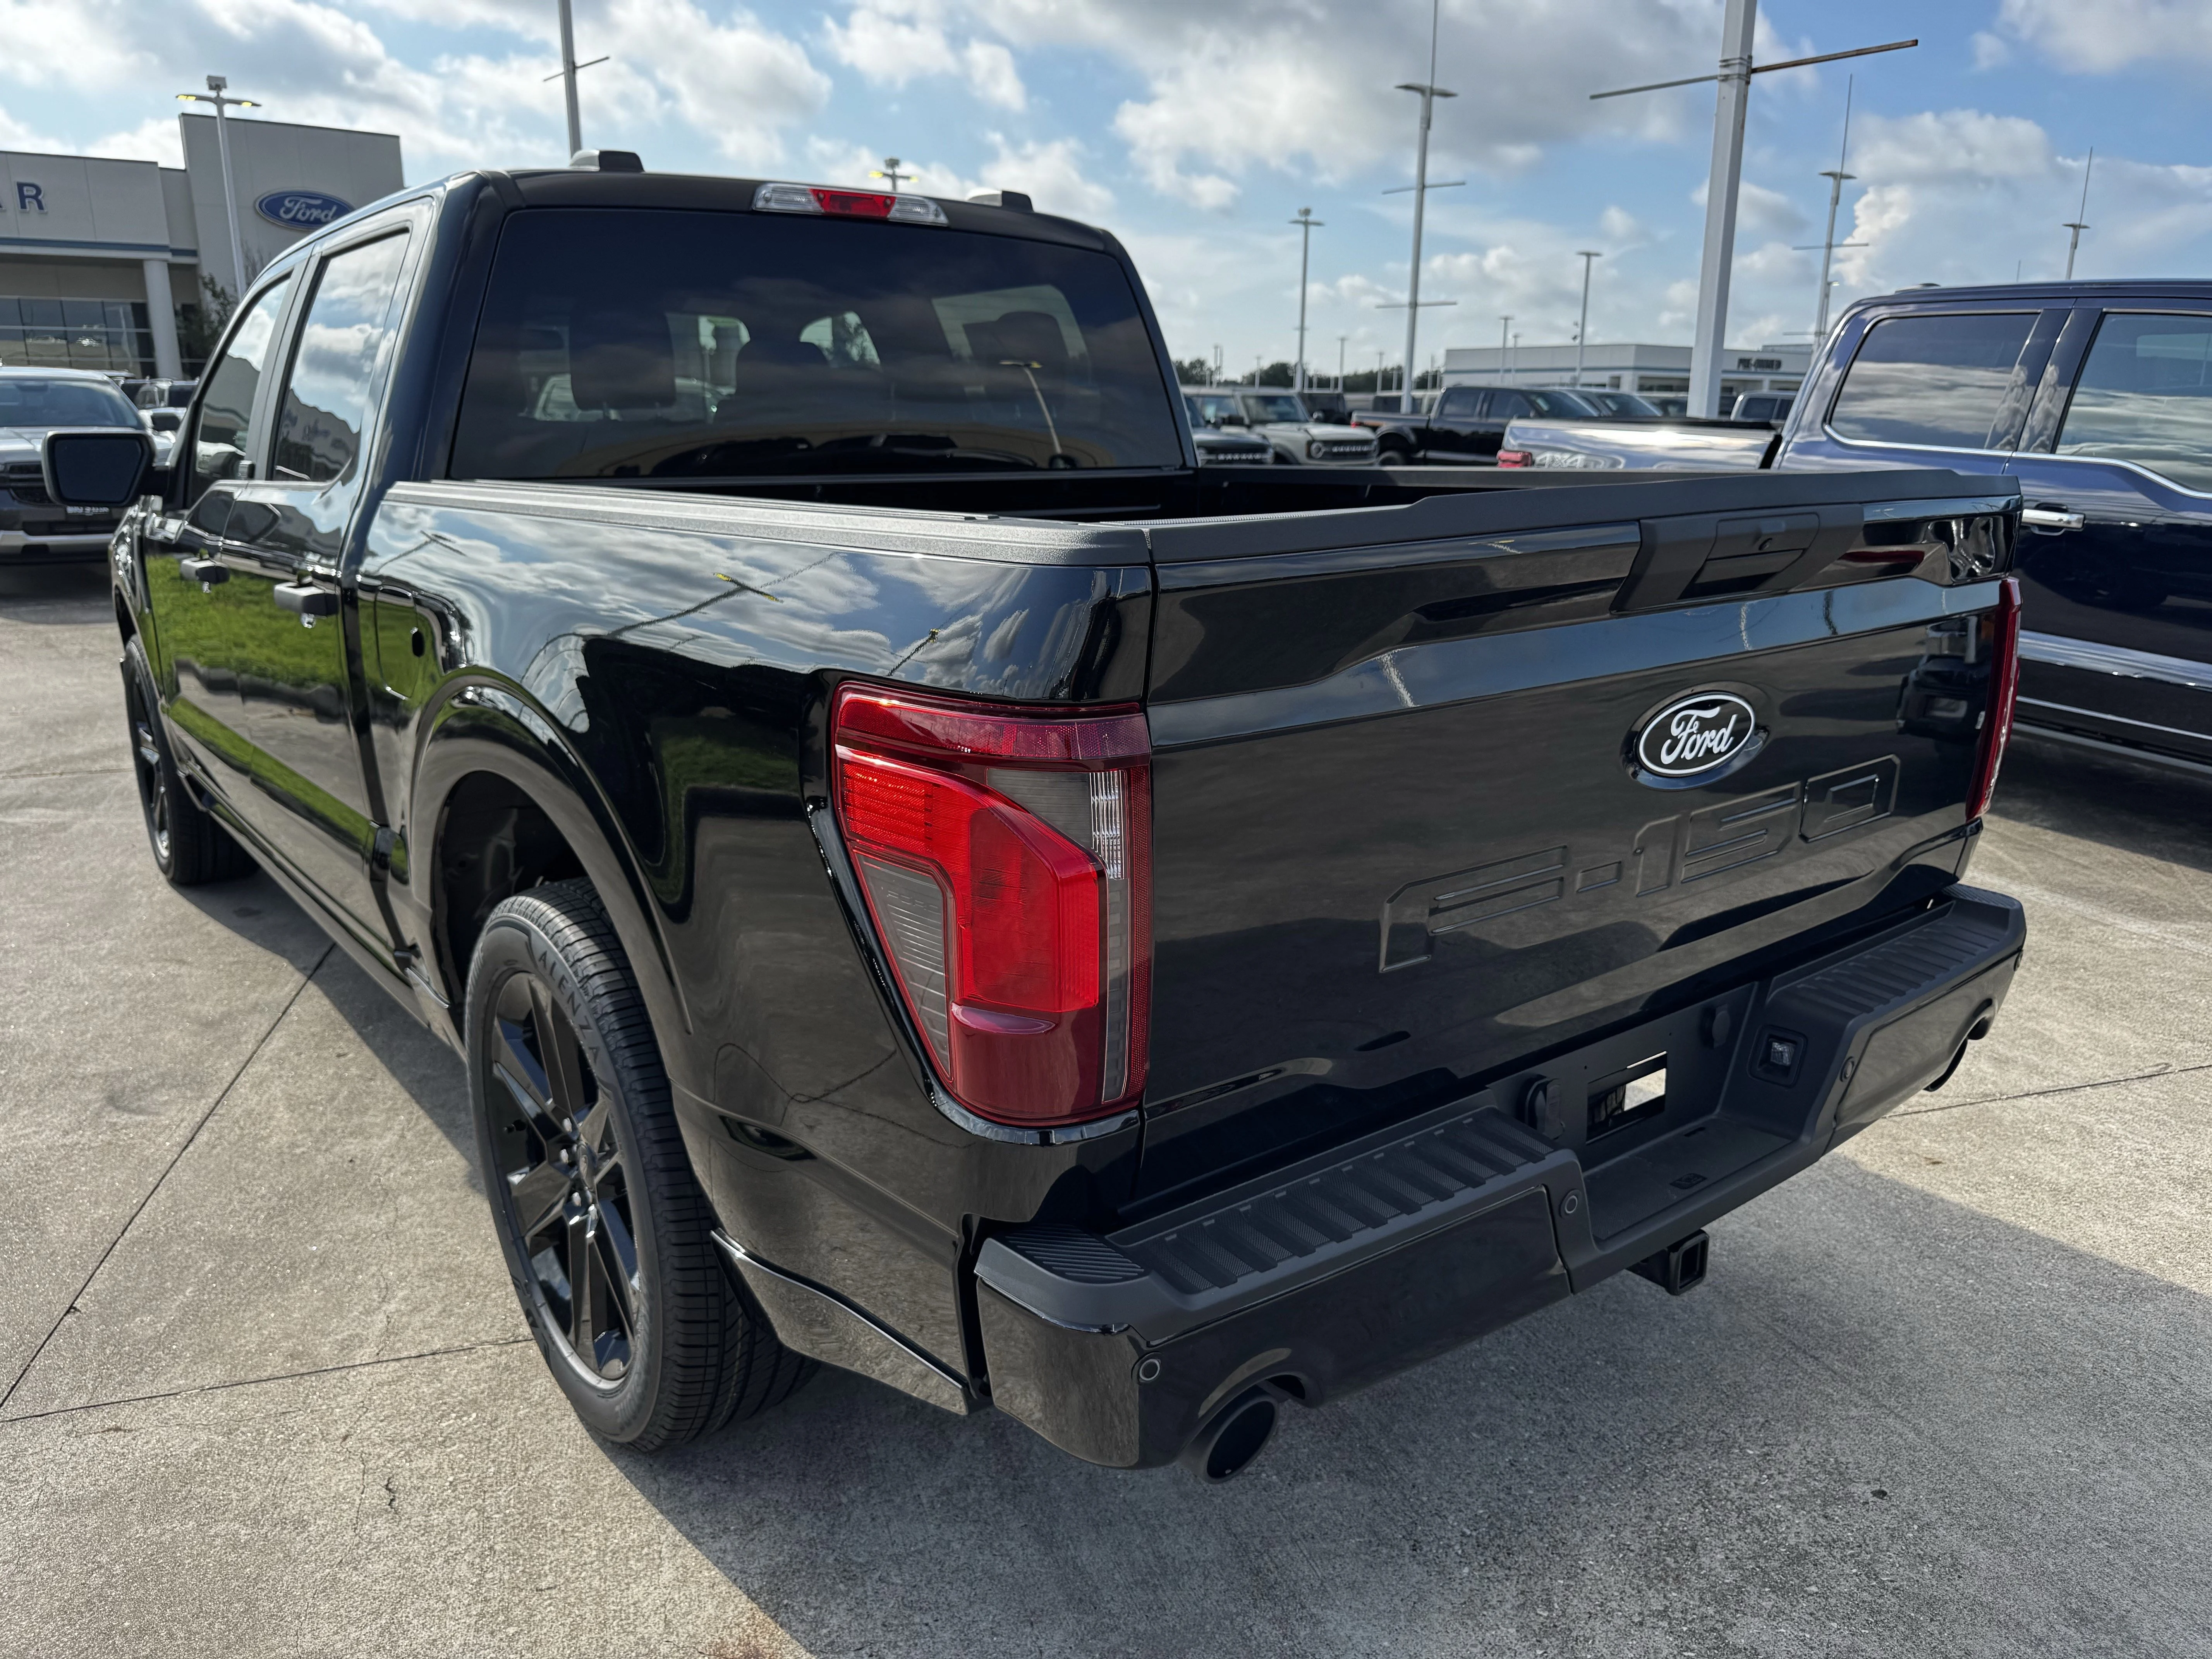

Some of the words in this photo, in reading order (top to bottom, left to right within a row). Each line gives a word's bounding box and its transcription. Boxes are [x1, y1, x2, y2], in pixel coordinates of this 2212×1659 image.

[0, 181, 44, 210] R
[279, 196, 337, 222] Ford
[1660, 706, 1737, 765] Ford
[1379, 754, 1900, 973] F-150
[538, 950, 599, 1065] ALENZA
